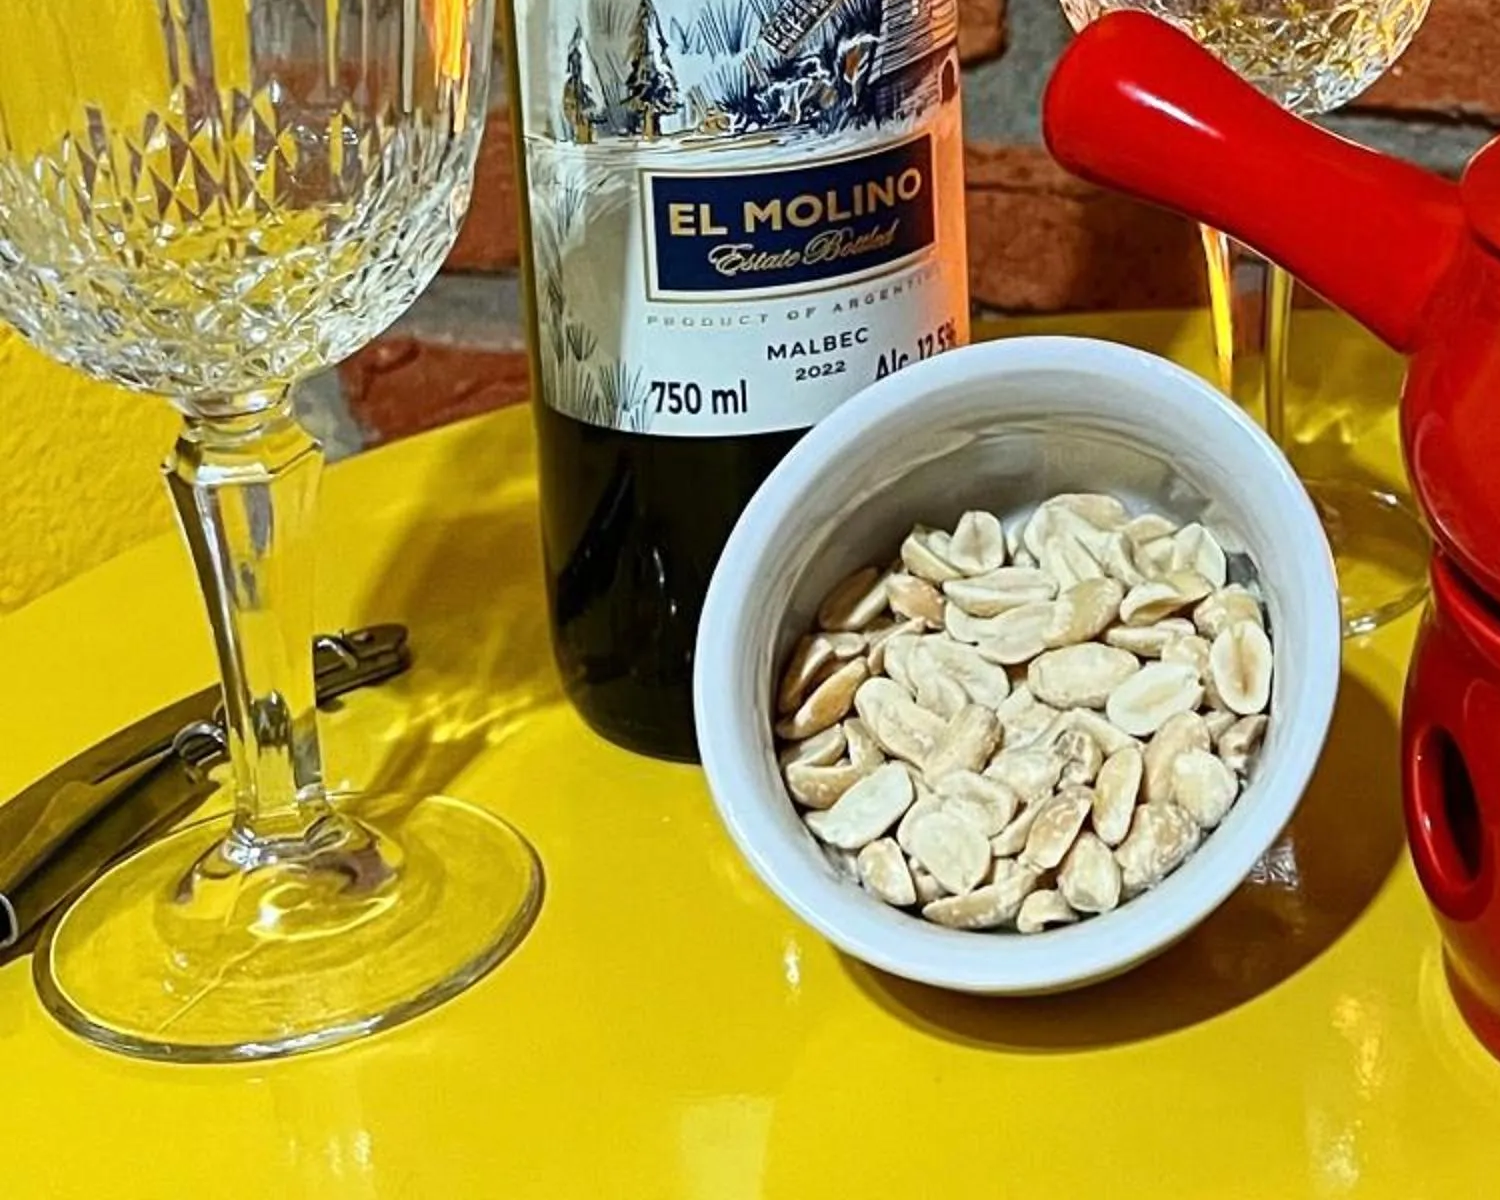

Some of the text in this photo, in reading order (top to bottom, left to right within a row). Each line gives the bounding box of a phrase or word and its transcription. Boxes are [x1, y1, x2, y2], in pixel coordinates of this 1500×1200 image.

[668, 167, 922, 236] EL MOLINO
[707, 243, 801, 277] Estate
[646, 313, 769, 327] PRODUCT
[787, 307, 816, 321] OF
[767, 327, 869, 361] MALBEC
[795, 360, 846, 381] 2022
[651, 378, 748, 415] 750 ml
